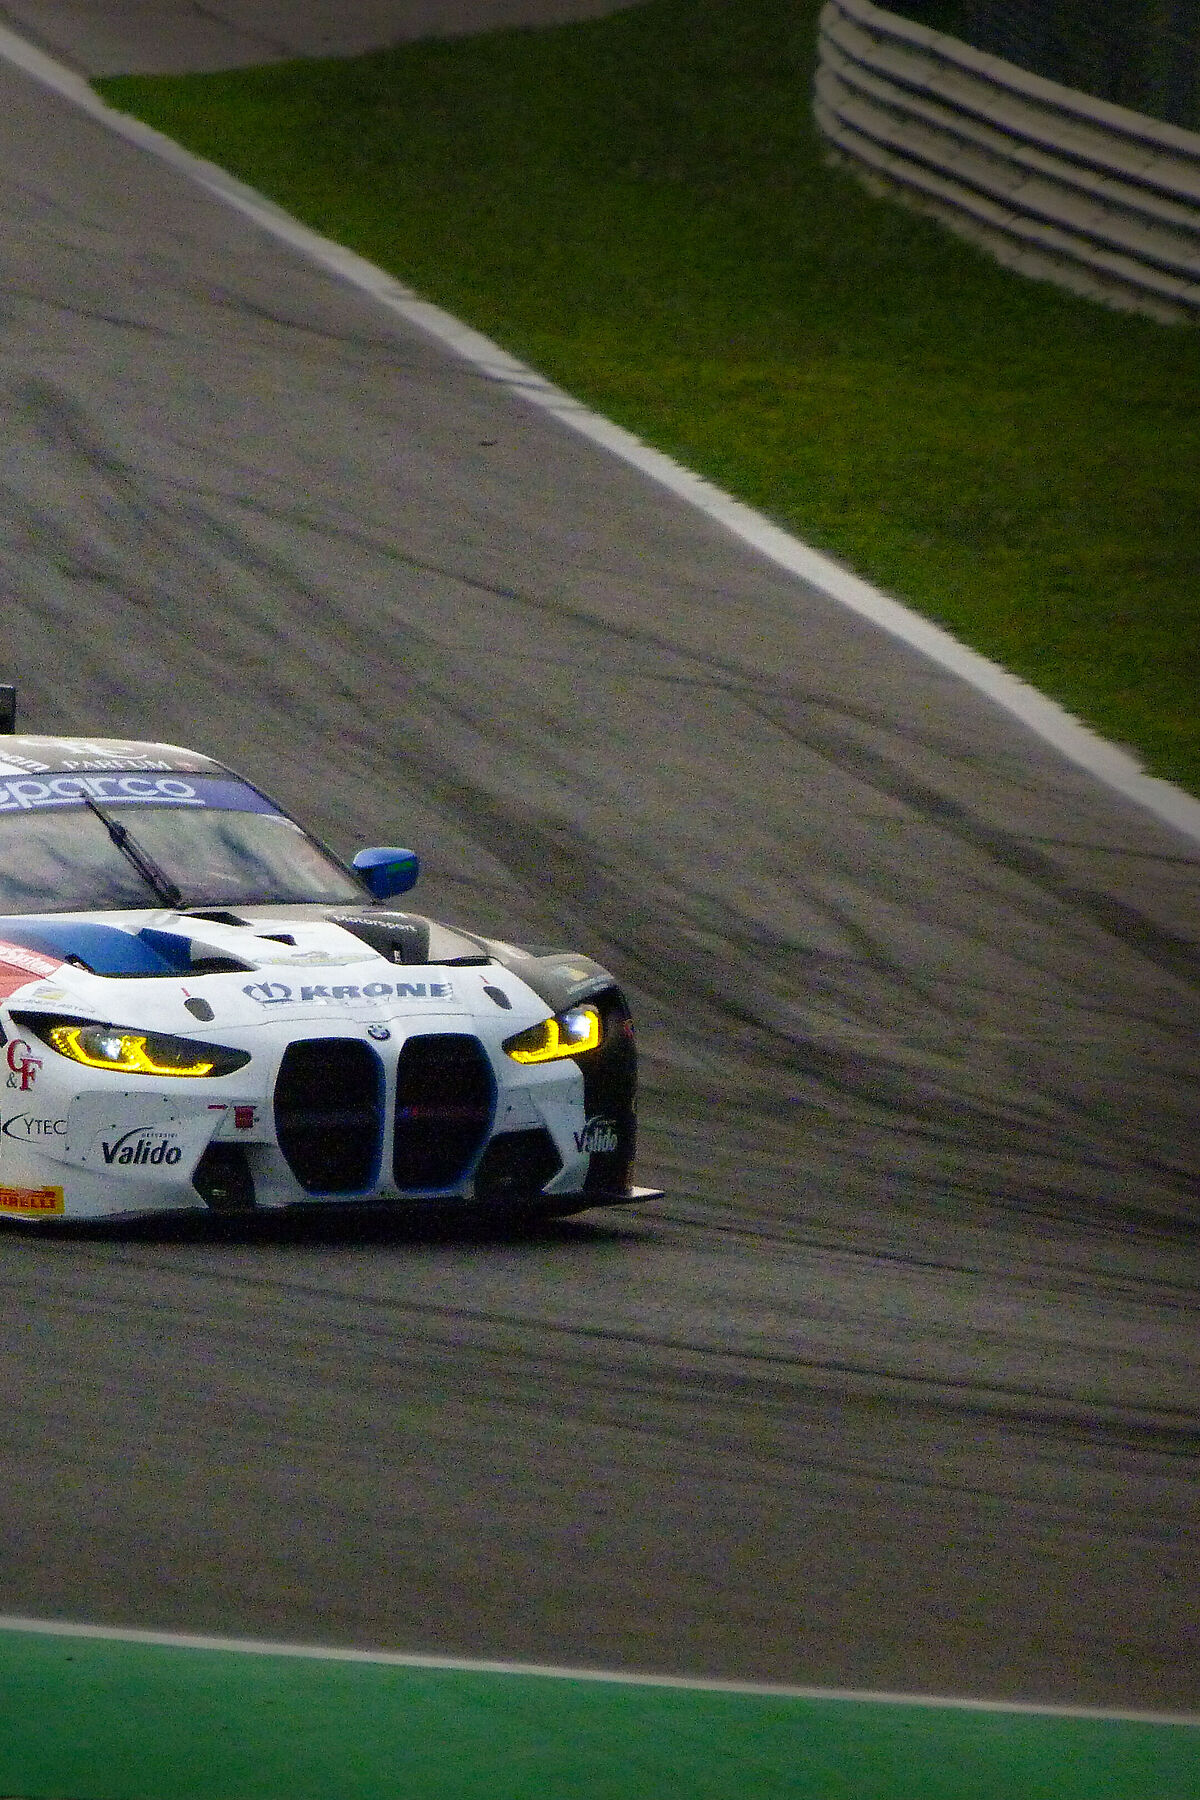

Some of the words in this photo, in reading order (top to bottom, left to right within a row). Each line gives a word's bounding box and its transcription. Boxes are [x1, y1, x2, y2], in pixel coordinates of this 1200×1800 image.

[61, 760, 172, 771] PARFUM
[301, 982, 453, 1001] KRONE
[102, 1127, 182, 1165] Valido
